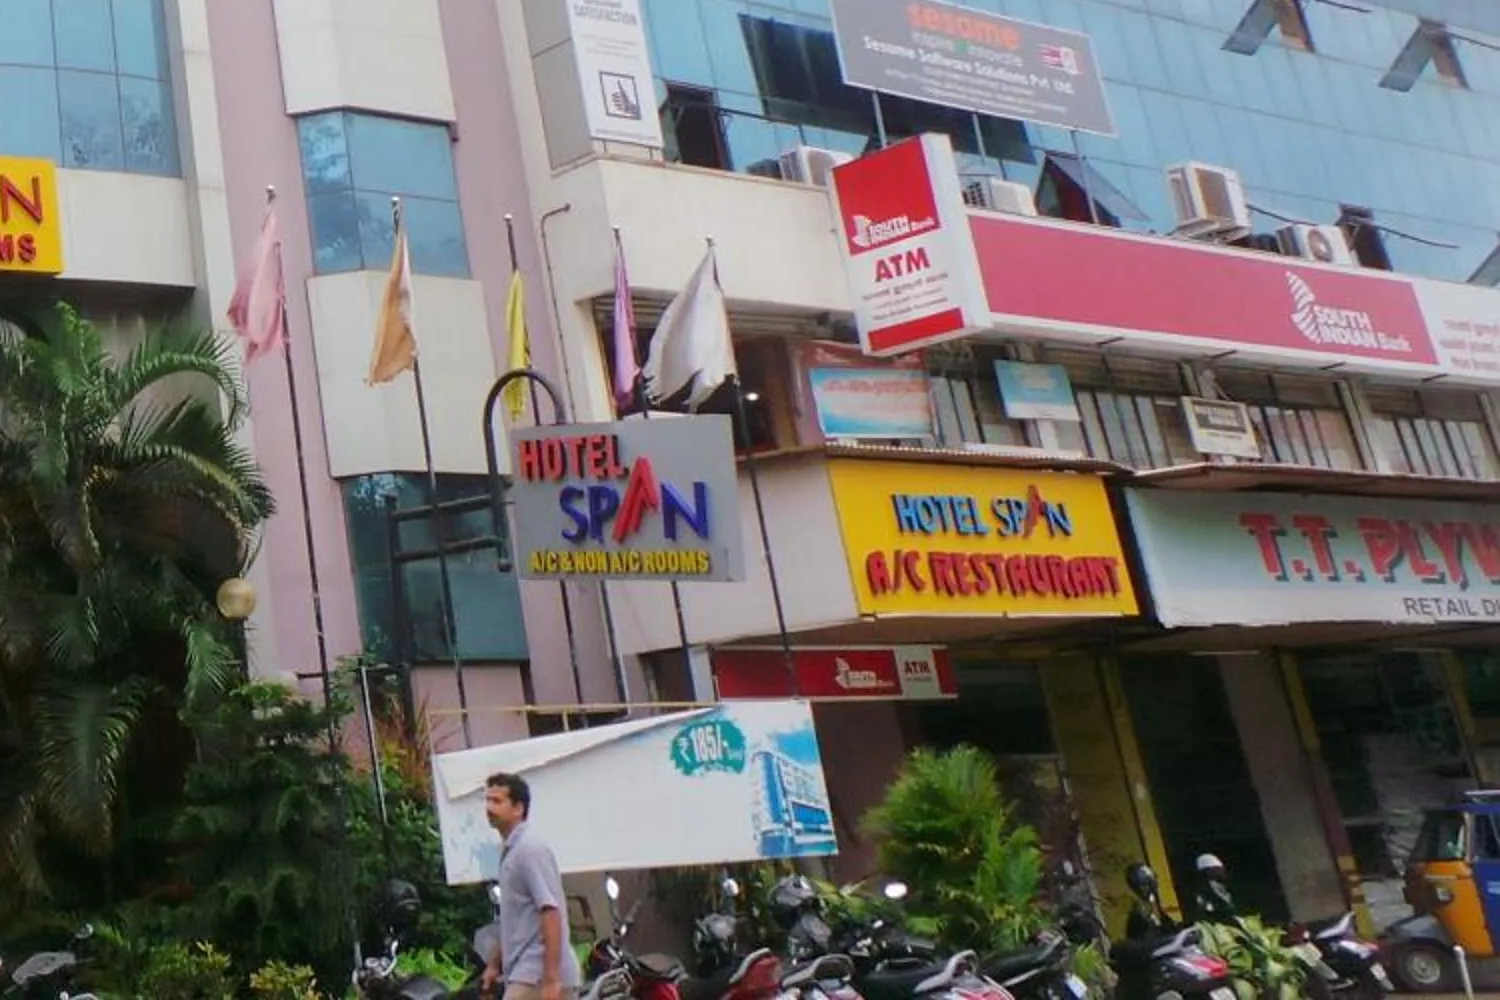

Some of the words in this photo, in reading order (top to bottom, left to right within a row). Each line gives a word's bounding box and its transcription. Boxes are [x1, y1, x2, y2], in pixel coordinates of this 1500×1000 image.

[875, 247, 931, 283] ATM
[1313, 304, 1373, 331] SOUTH
[1316, 324, 1380, 349] INDIAN
[520, 433, 630, 482] HOTEL
[559, 455, 710, 545] SPAN
[891, 493, 989, 537] HOTEL
[991, 484, 1073, 540] SPAN
[575, 551, 611, 574] NON
[644, 550, 711, 573] ROOMS
[866, 549, 925, 598] A/C
[927, 551, 1121, 599] RESTAURANT
[1403, 597, 1480, 617] RETAIL
